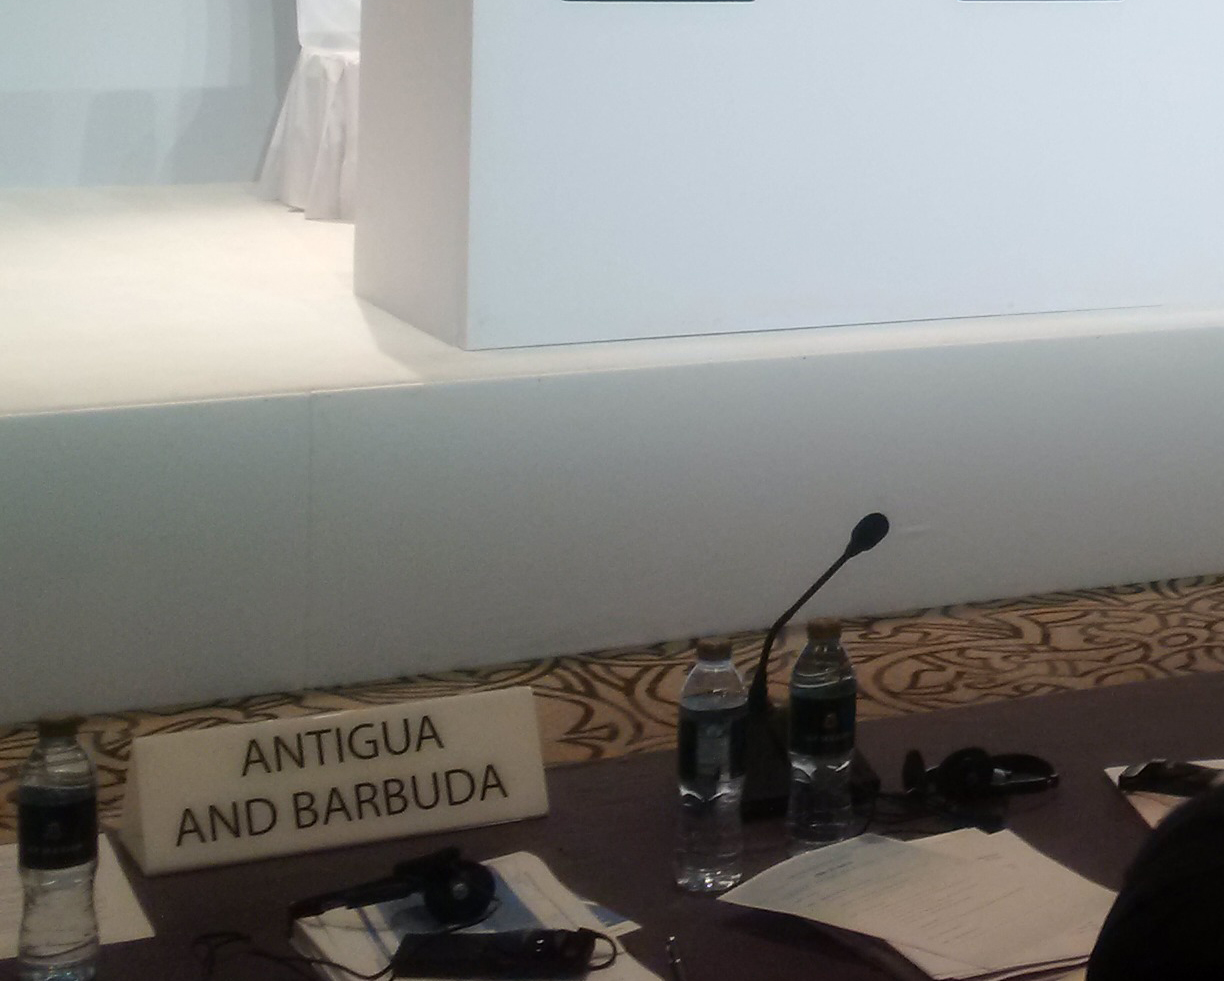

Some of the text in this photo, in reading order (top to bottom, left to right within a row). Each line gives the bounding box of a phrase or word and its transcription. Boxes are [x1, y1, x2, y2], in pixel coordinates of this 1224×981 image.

[241, 714, 445, 778] ANTIGUA
[175, 763, 509, 848] AND BARBUDA
